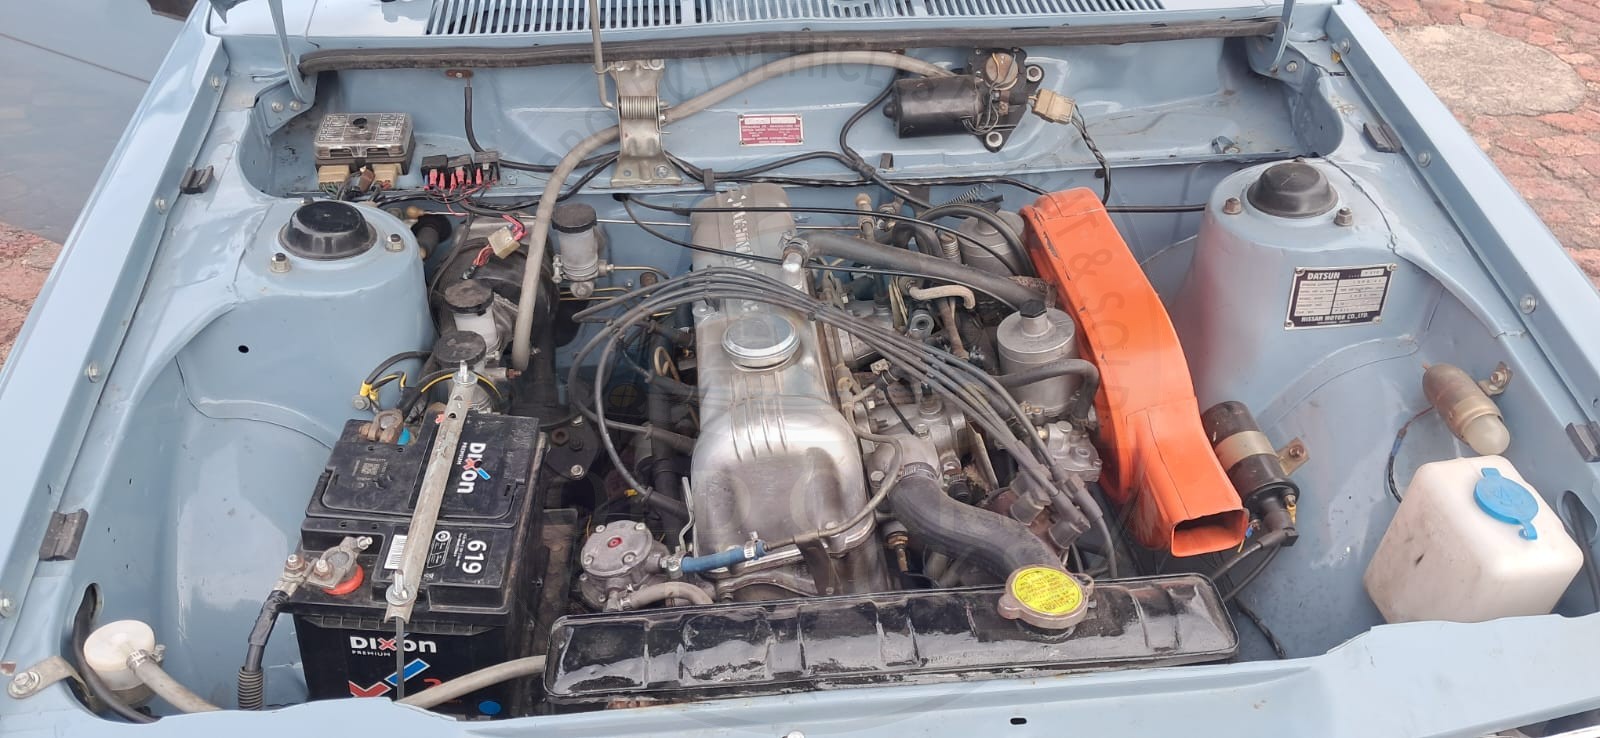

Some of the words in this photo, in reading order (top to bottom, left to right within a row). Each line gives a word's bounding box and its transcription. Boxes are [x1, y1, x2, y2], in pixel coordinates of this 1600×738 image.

[1307, 272, 1340, 280] DATSUN
[457, 442, 468, 465] PREMIUM
[463, 539, 487, 574] 619
